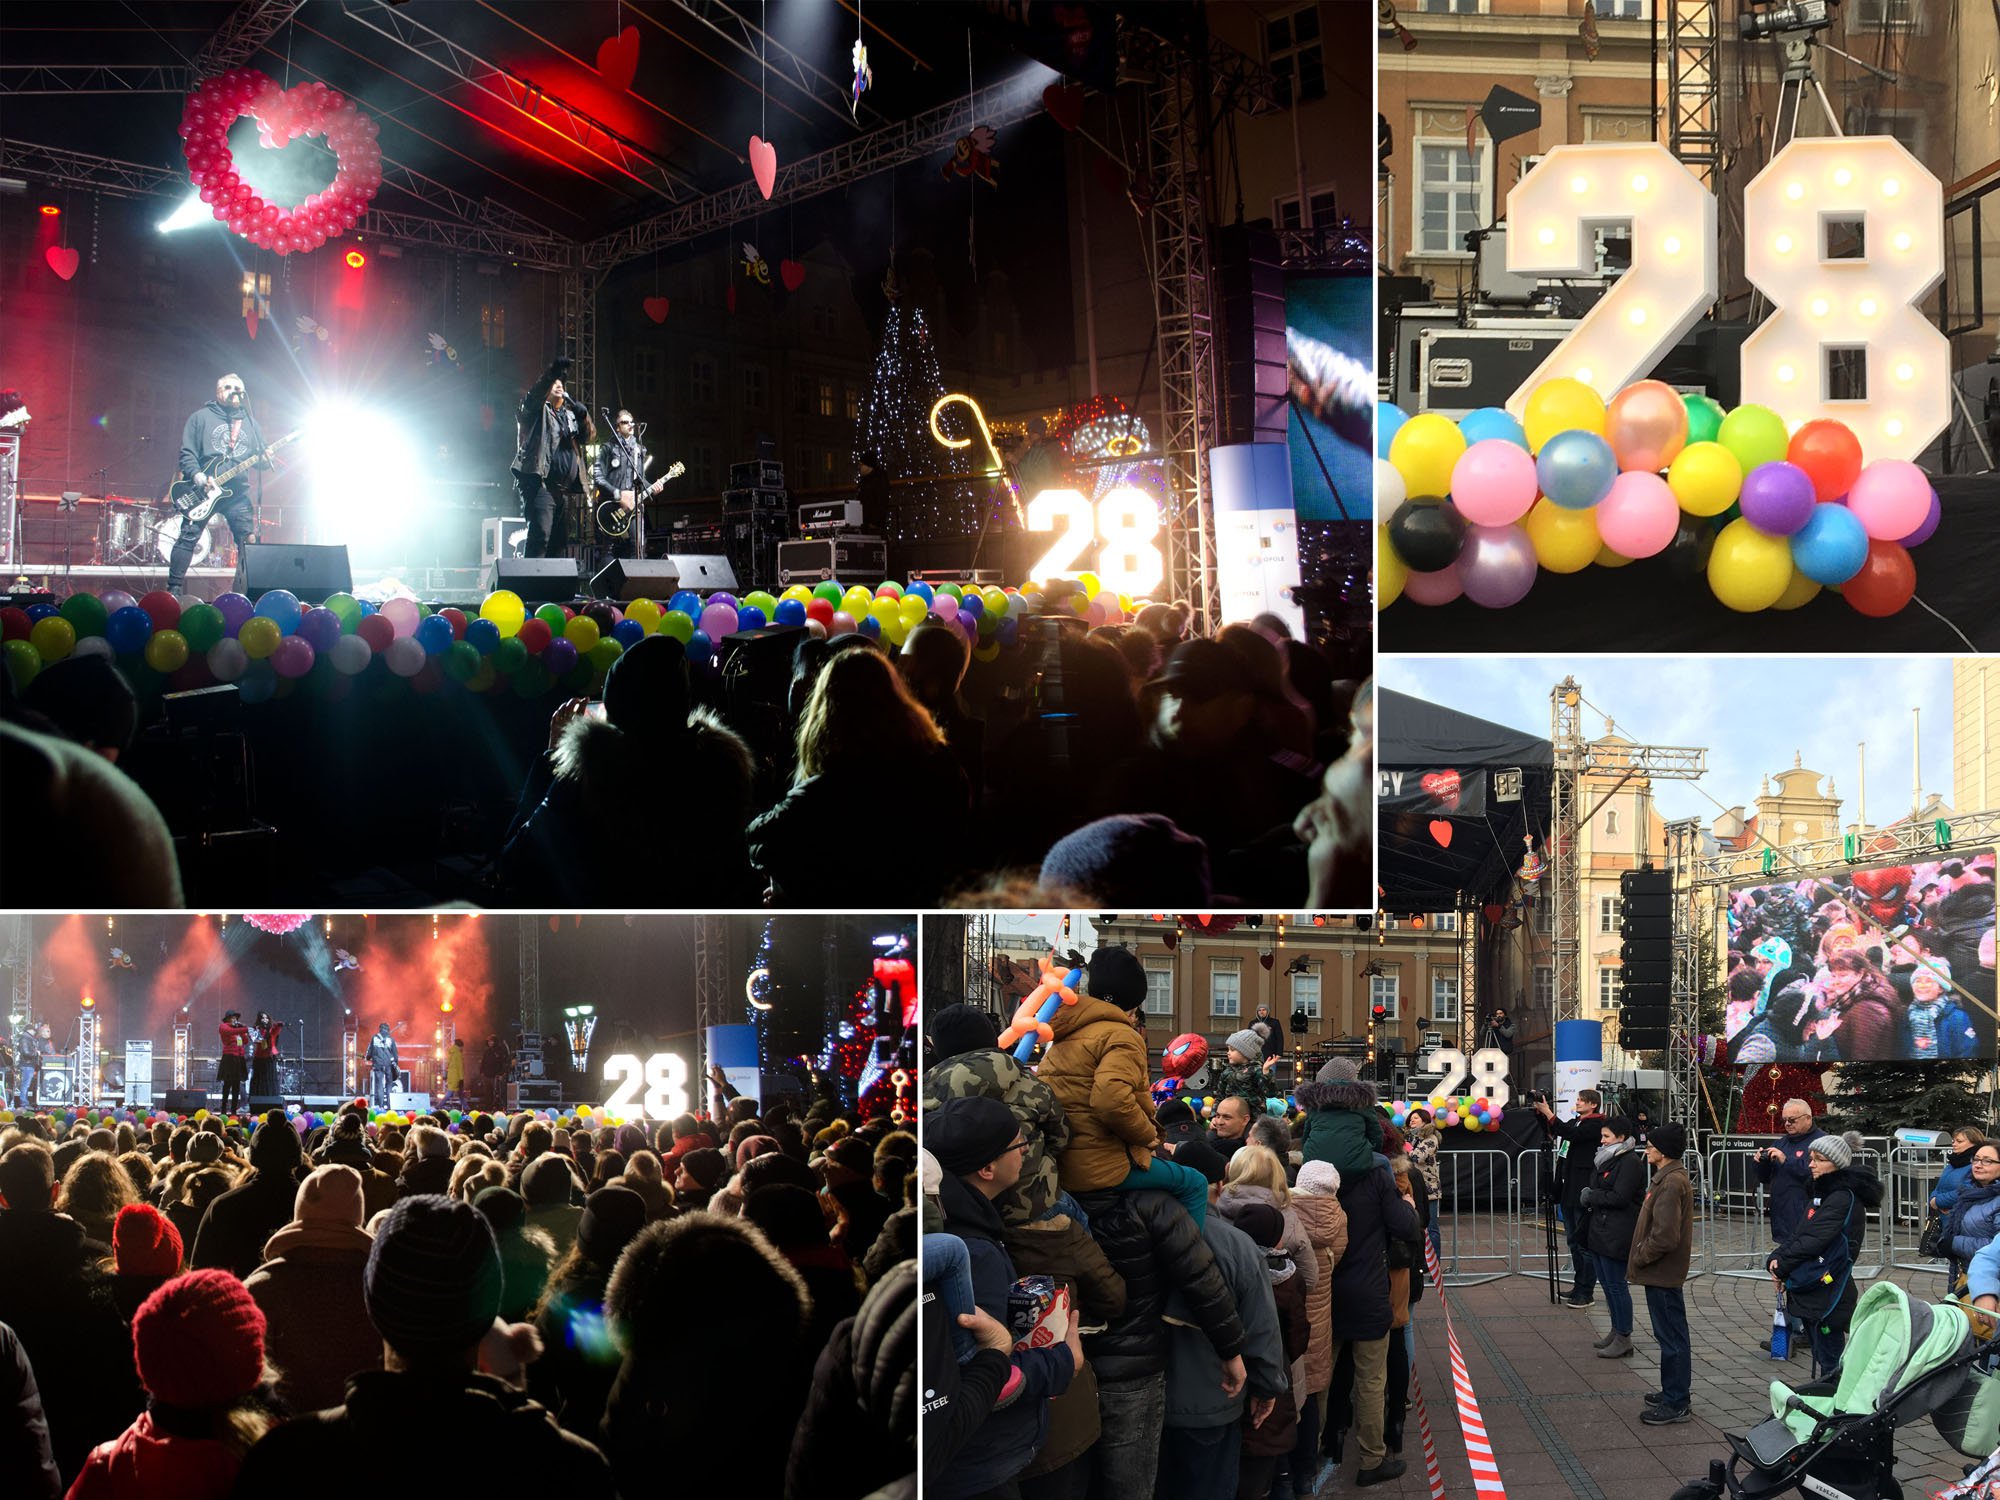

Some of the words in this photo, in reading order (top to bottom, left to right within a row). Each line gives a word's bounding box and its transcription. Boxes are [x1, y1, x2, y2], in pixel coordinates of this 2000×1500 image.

[1506, 136, 1951, 470] 28
[1027, 488, 1164, 598] 28
[603, 1053, 689, 1121] 28
[1427, 1047, 1511, 1109] 28
